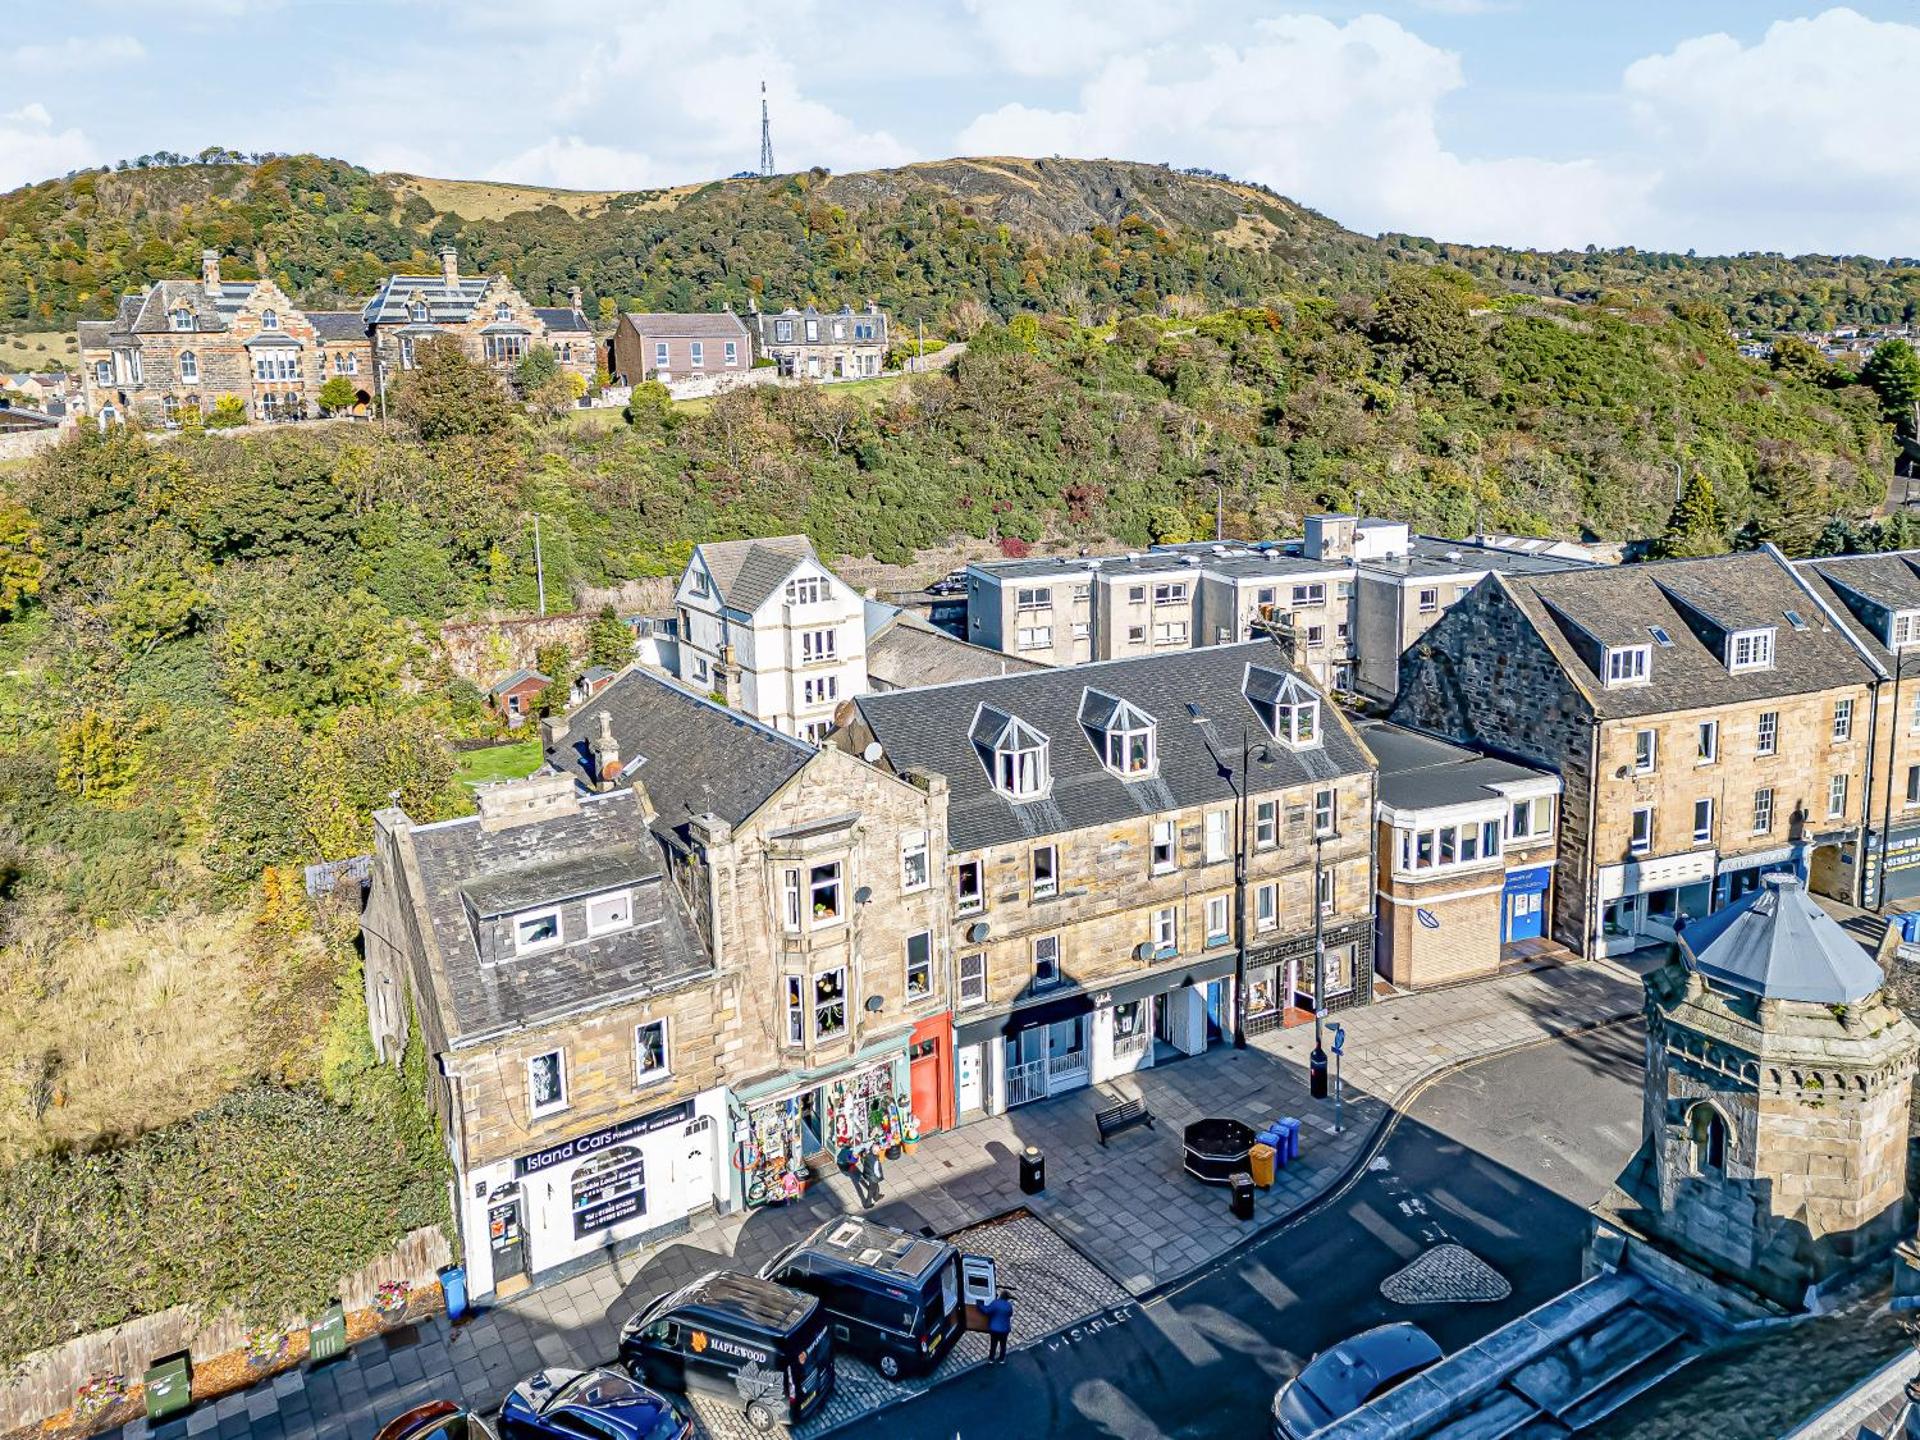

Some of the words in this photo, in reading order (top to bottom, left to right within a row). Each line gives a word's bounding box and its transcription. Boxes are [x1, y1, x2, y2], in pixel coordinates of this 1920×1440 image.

[526, 1142, 573, 1171] Island
[576, 1131, 612, 1153] Cars
[711, 1340, 767, 1362] MAPLEWOOD
